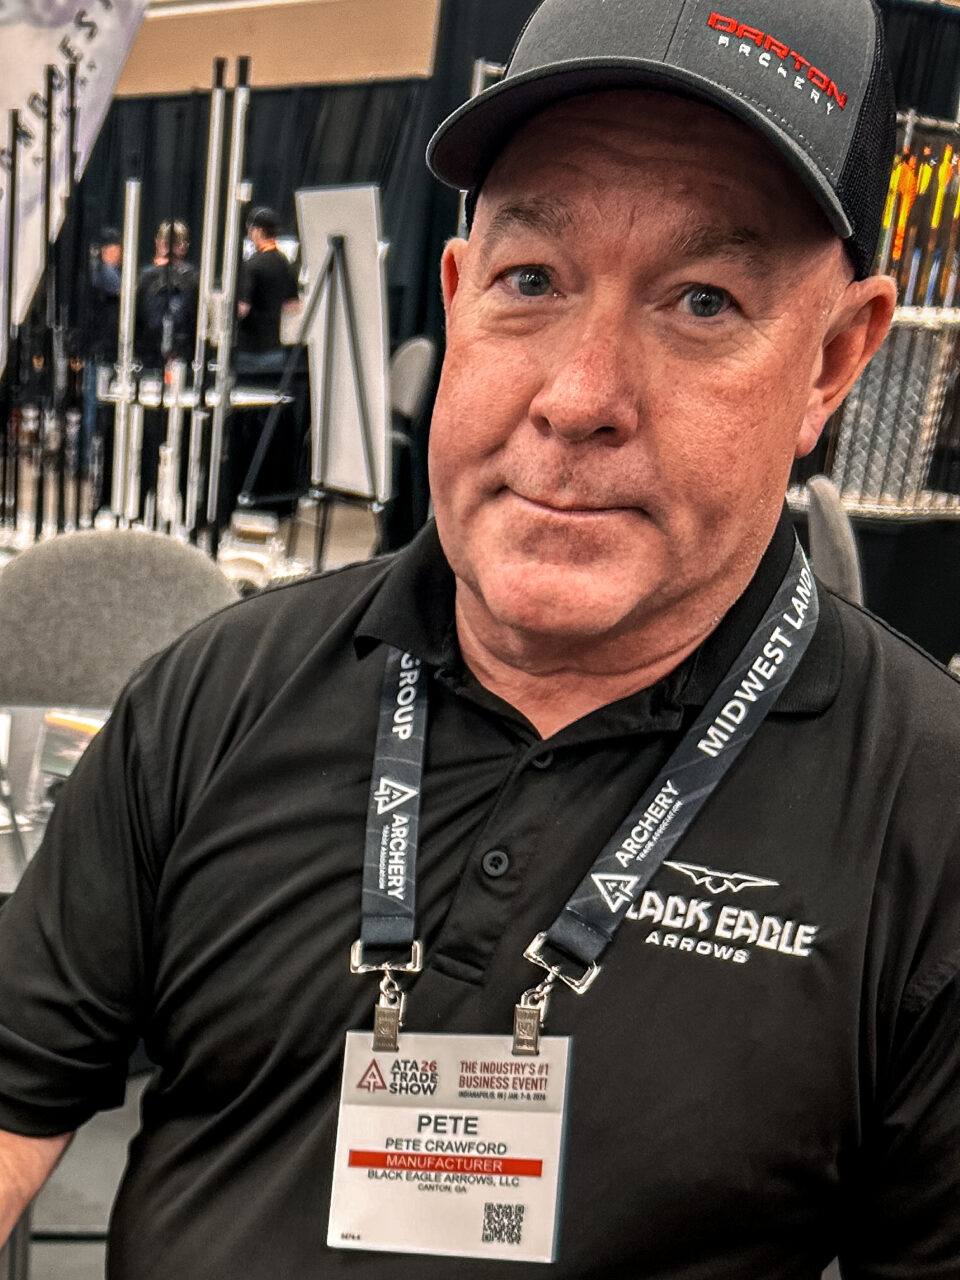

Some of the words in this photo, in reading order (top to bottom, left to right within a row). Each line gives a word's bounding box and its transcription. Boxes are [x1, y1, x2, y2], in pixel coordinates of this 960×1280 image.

[707, 11, 848, 110] DARTON
[393, 653, 420, 740] GROUP
[697, 626, 792, 758] MIDWEST
[614, 779, 681, 868] ARCHERY
[387, 814, 409, 900] ARCHERY
[714, 905, 819, 957] EAGLE
[645, 929, 750, 964] ARROWS
[391, 1059, 419, 1072] ATA
[420, 1060, 438, 1073] 26
[460, 1060, 477, 1074] THE
[479, 1061, 536, 1075] INDUSTRY'S
[537, 1063, 549, 1076] #1
[391, 1071, 438, 1083] TRADE
[459, 1075, 510, 1090] BUSINESS
[512, 1077, 548, 1091] EVENT!
[389, 1082, 438, 1096] SHOW
[417, 1114, 479, 1135] PETE
[385, 1137, 421, 1151] PETE
[425, 1139, 507, 1155] CRAWFORD
[386, 1155, 503, 1172] MANUFACTURER
[367, 1169, 403, 1181] BLACK
[406, 1171, 440, 1183] EAGLE
[499, 1176, 520, 1187] LLC
